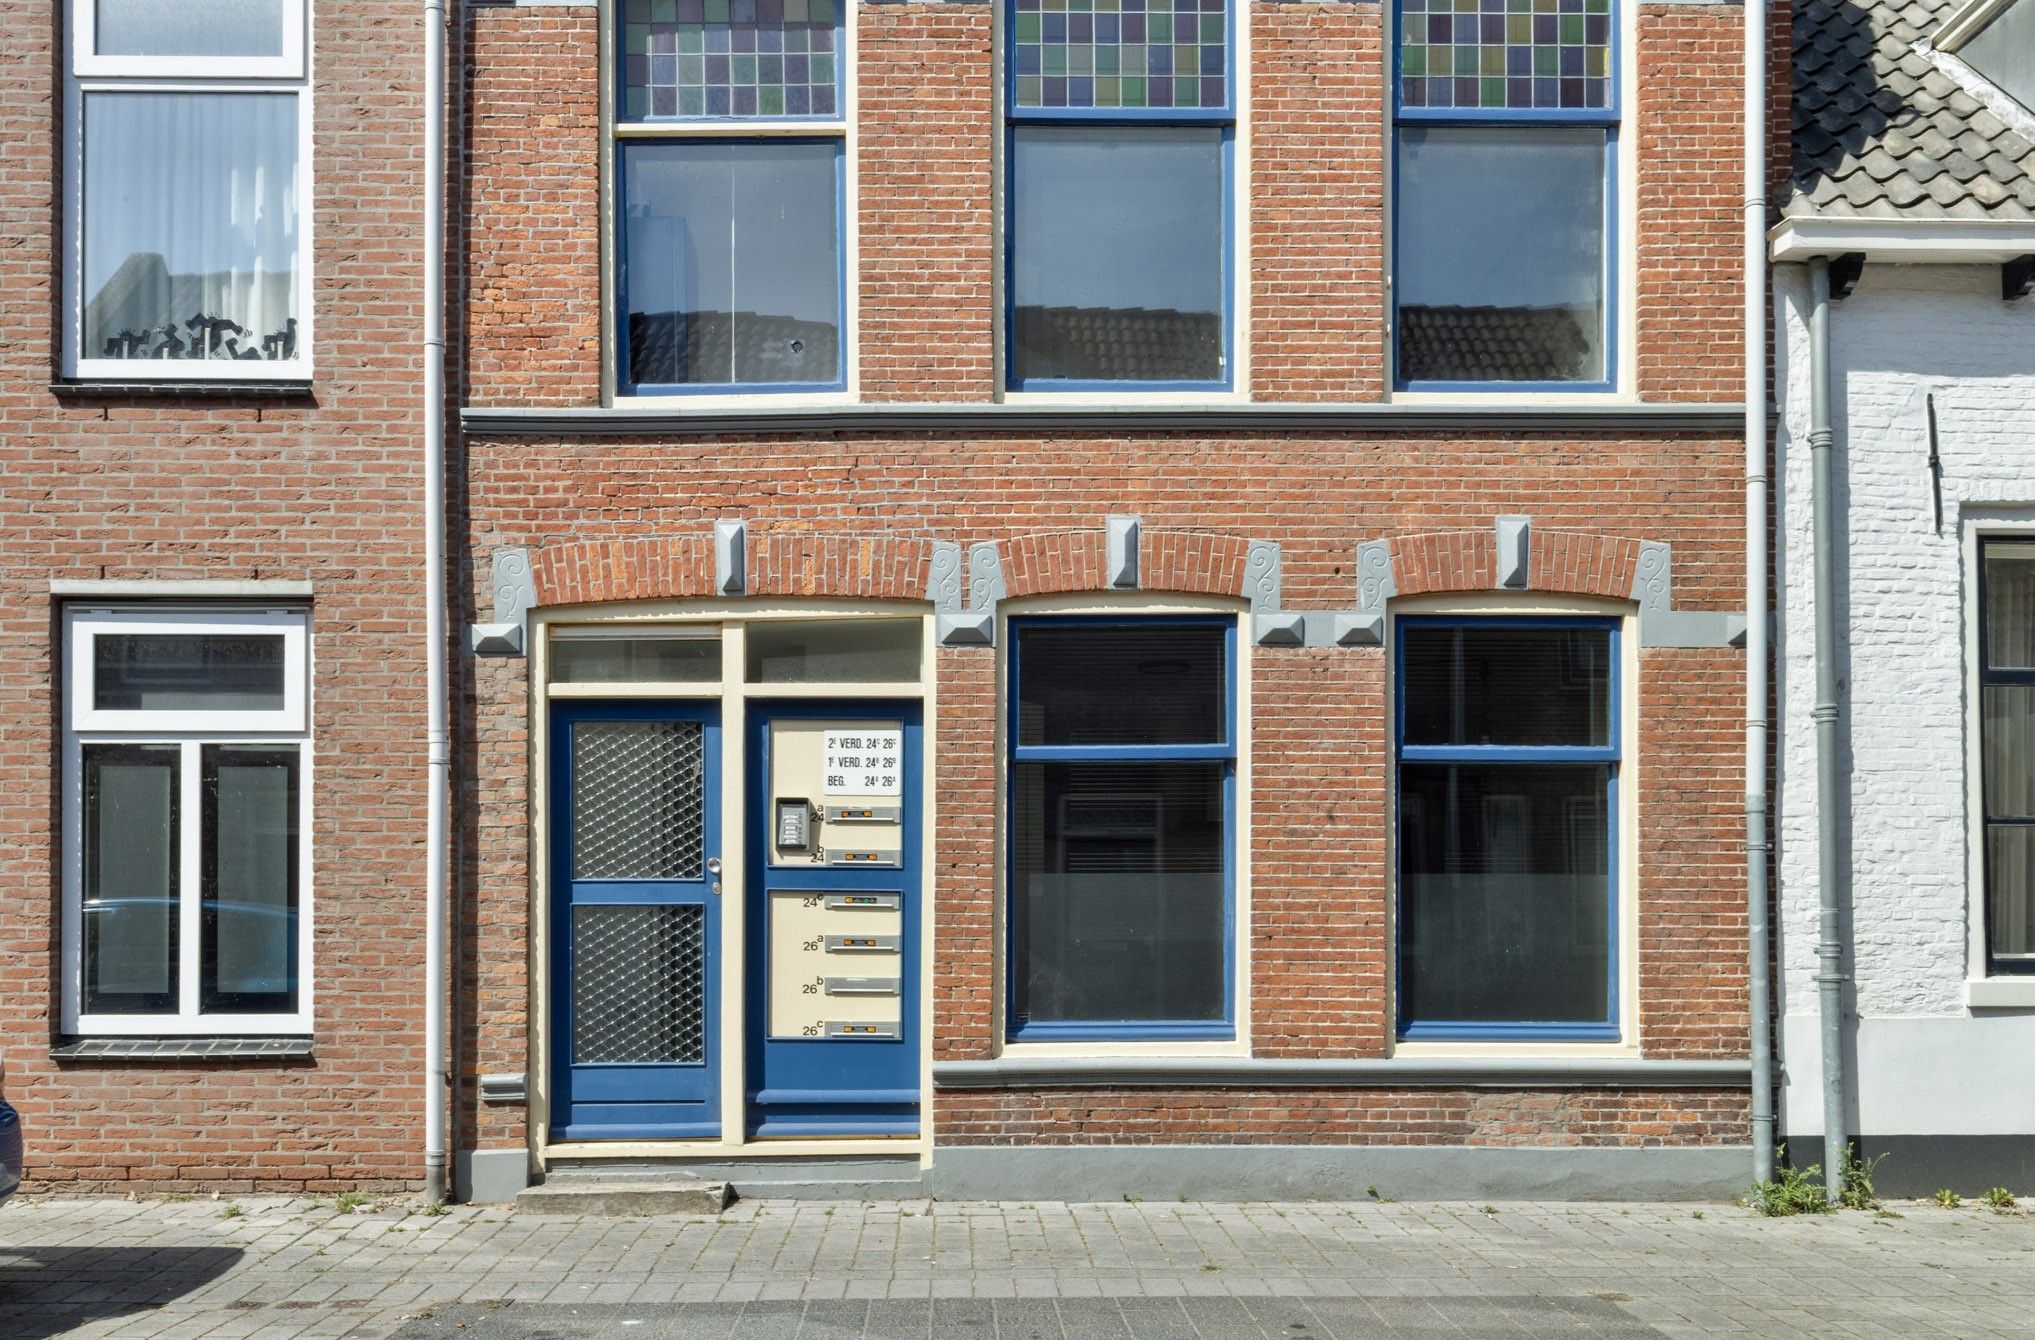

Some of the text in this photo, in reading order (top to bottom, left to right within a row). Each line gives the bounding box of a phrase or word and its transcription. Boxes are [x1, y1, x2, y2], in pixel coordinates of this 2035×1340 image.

[840, 737, 864, 749] VERD.
[838, 756, 863, 768] VERD.
[827, 775, 847, 787] BEG.
